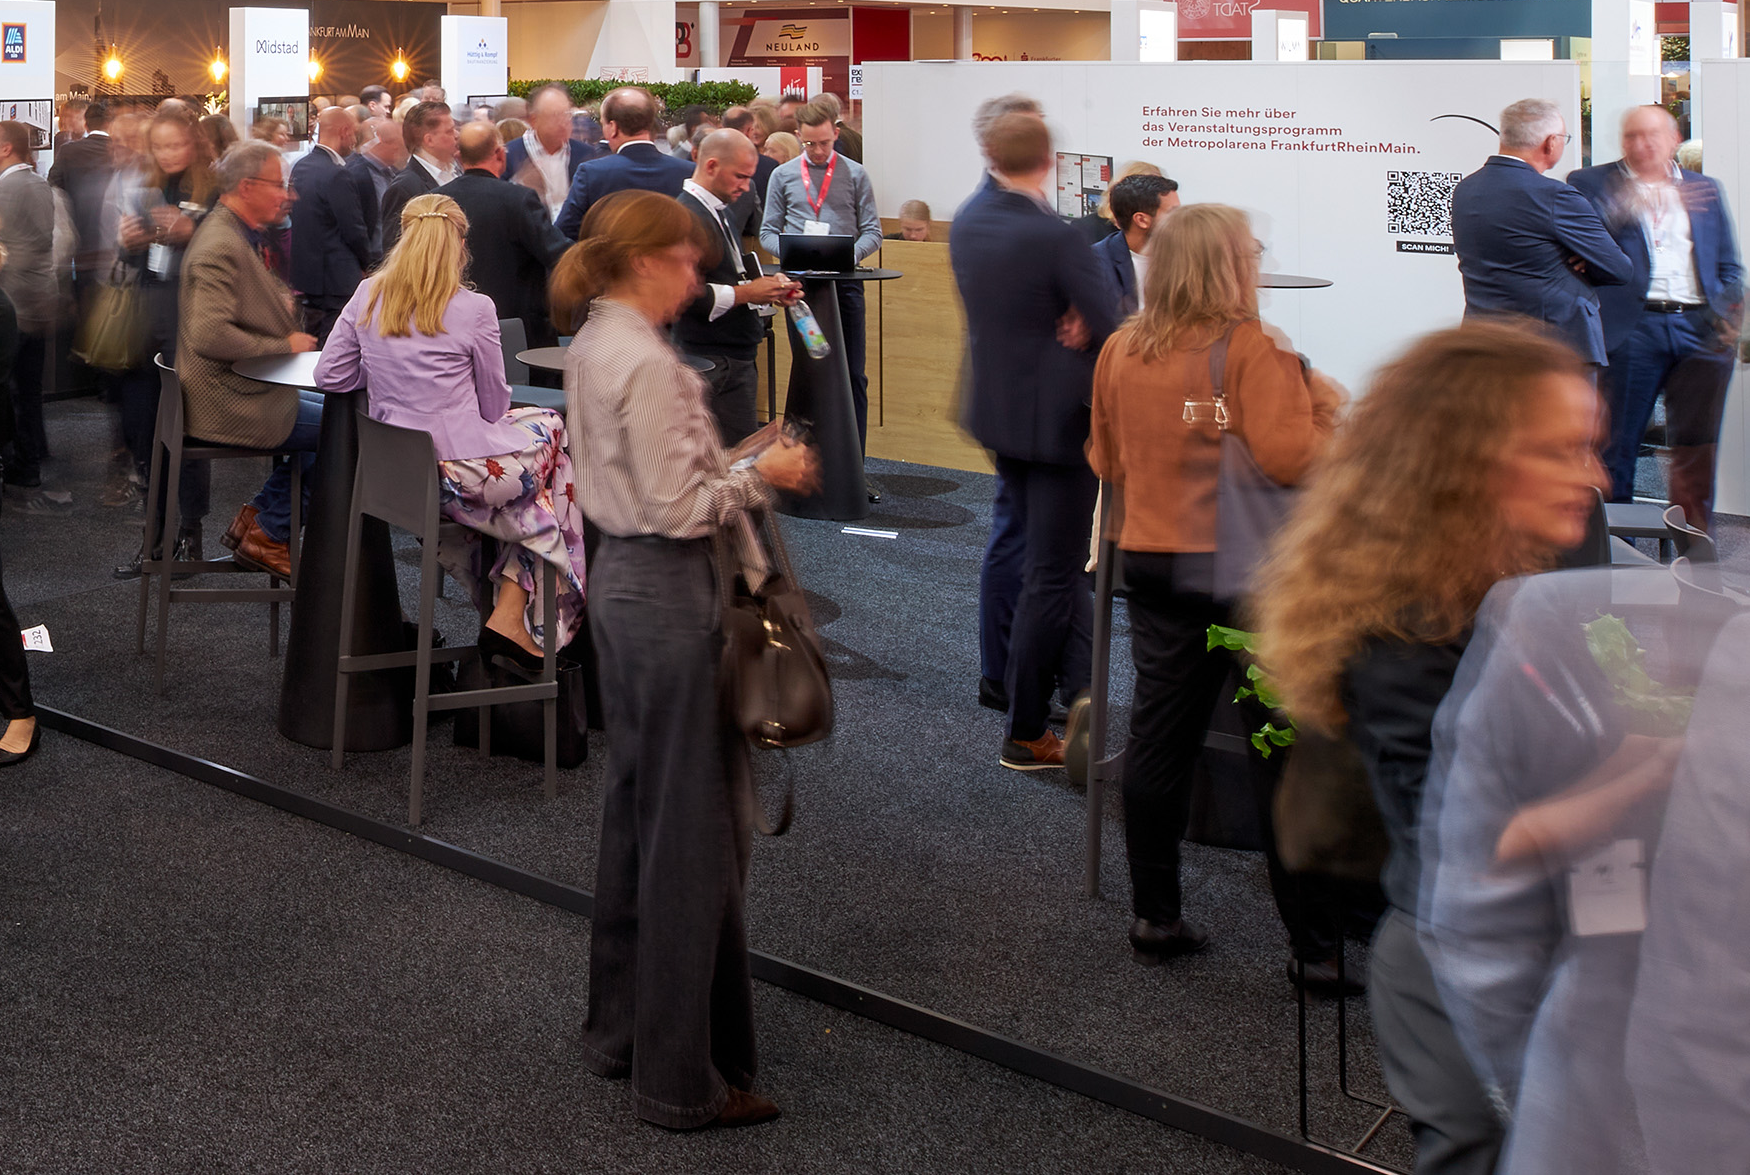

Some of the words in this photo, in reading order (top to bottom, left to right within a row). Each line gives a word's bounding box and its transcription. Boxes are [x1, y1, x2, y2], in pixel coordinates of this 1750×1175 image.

[5, 45, 23, 54] ALDI
[766, 43, 819, 52] NEULAND
[1142, 106, 1197, 117] Erfahren
[1201, 107, 1221, 118] Sie
[1225, 107, 1260, 118] mehr
[1264, 107, 1296, 119] über
[1142, 121, 1164, 132] das
[1168, 121, 1342, 138] Veranstaltungsprogramm
[1142, 136, 1164, 147] der
[1167, 137, 1267, 151] Metropolarena
[1271, 139, 1421, 155] FrankfurtRheinMain.
[1401, 243, 1423, 252] SCAN
[1424, 244, 1449, 253] MICH!
